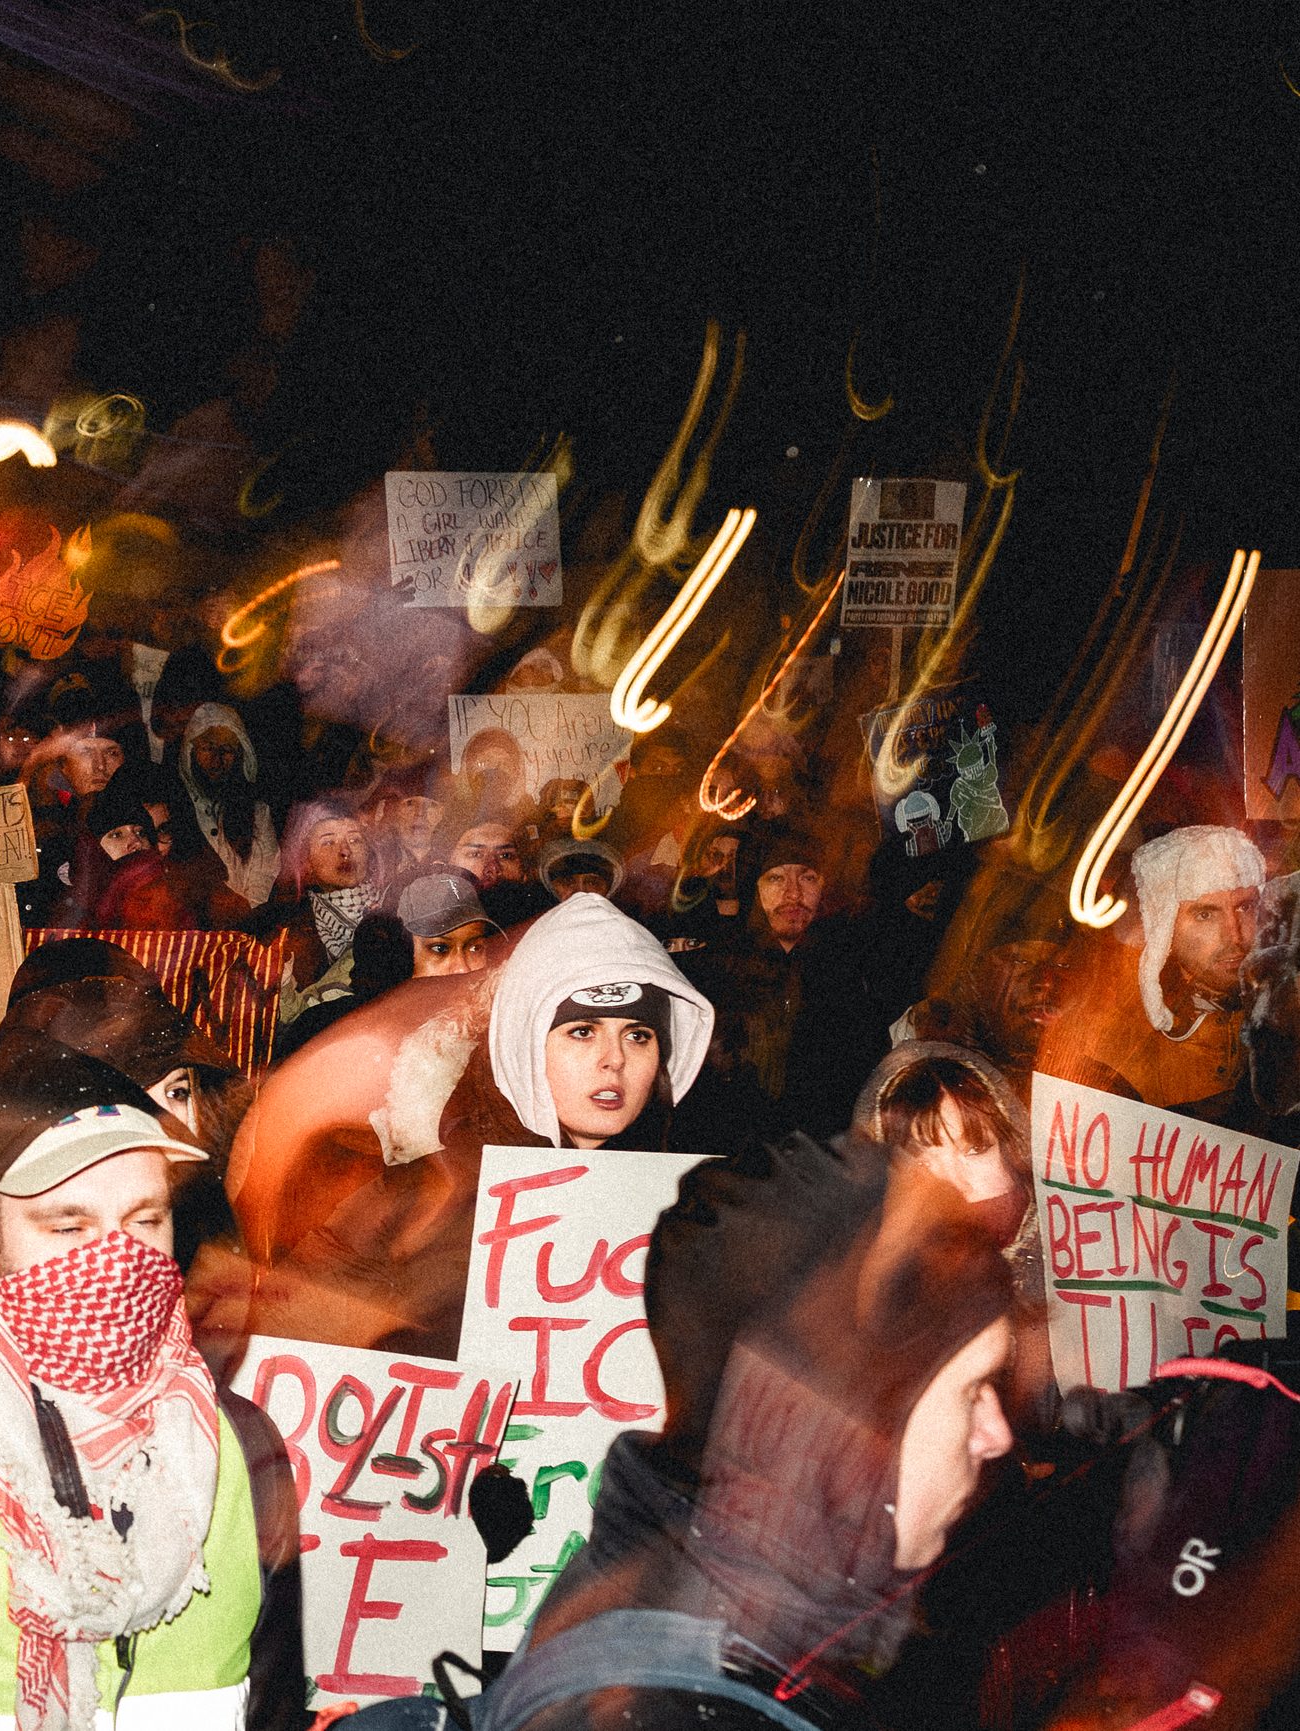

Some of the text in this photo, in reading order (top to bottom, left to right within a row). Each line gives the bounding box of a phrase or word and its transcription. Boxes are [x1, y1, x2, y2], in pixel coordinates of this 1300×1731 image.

[398, 479, 448, 509] GOD
[422, 512, 462, 535] GIRL
[851, 522, 958, 550] JUSTICE FOR
[847, 580, 952, 605] NICOLE GOOD
[1043, 1100, 1283, 1224] NO HUMAN
[1047, 1193, 1268, 1311] BEING IS
[507, 1316, 661, 1424] IC
[250, 1353, 514, 1522] BOLISH
[1172, 1537, 1222, 1597] OR
